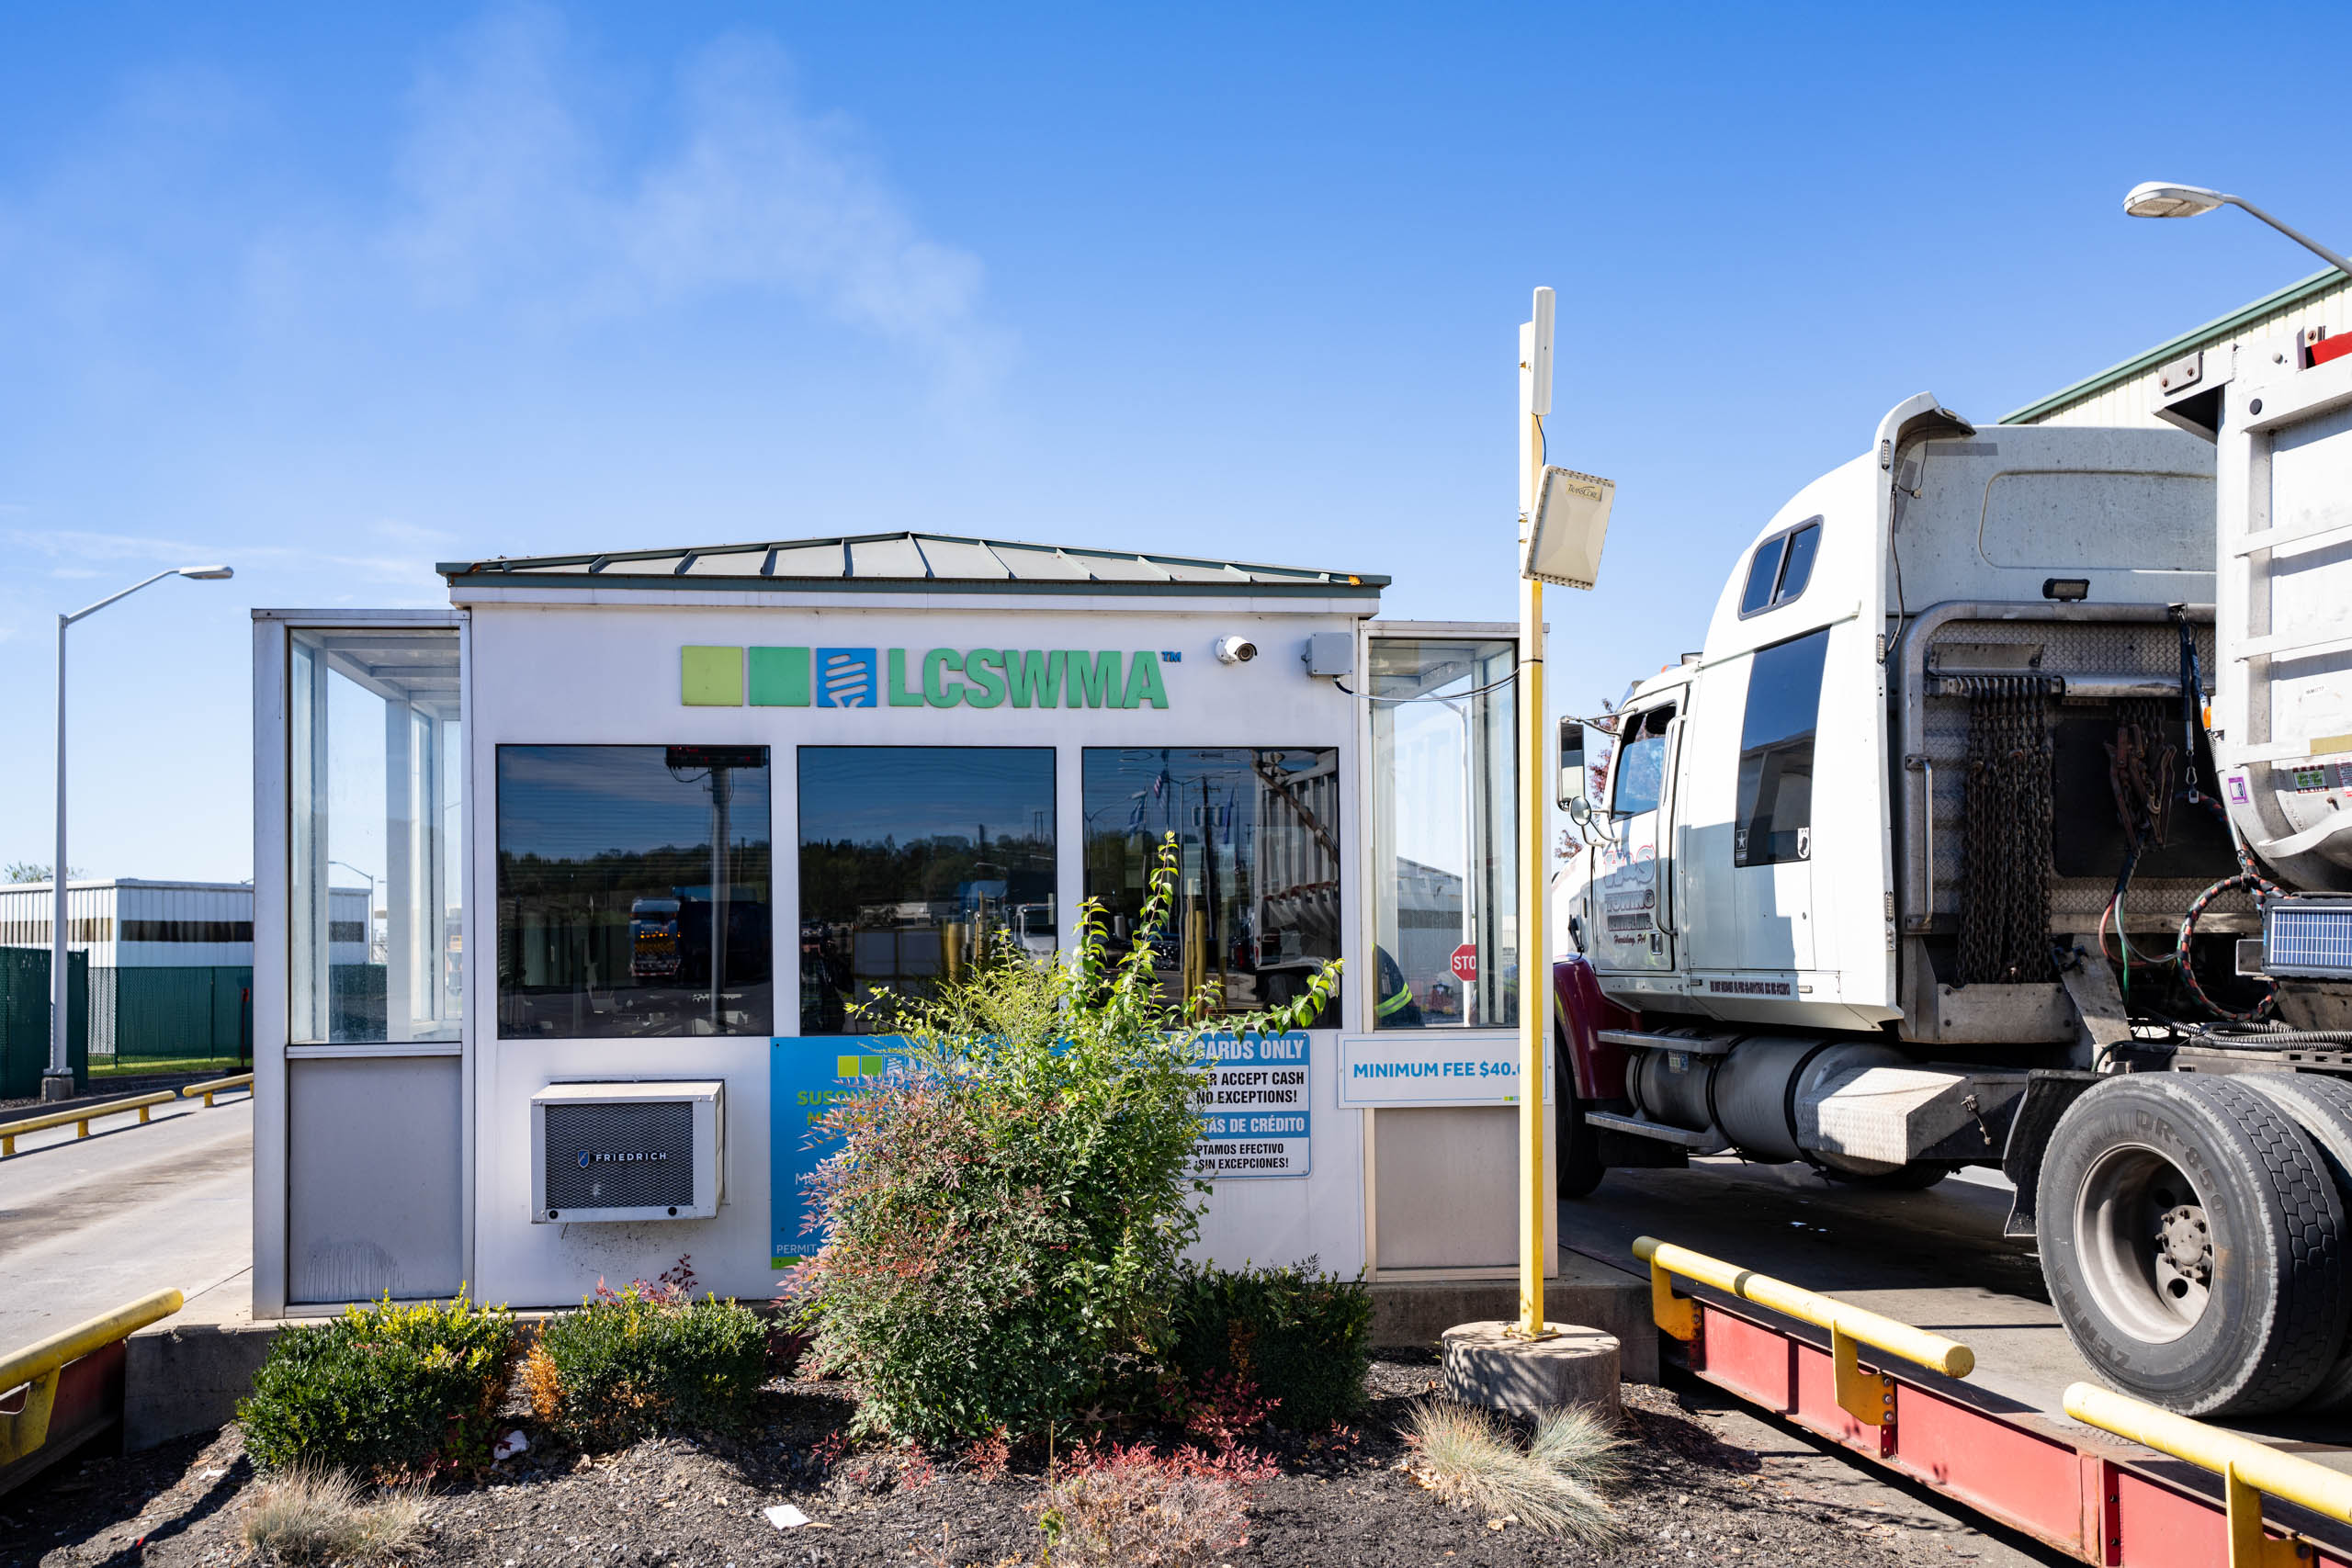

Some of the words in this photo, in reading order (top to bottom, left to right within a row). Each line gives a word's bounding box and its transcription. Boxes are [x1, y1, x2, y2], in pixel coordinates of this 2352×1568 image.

[888, 647, 1169, 709] LCSWMA
[1453, 955, 1476, 970] STO
[1260, 1039, 1304, 1059] ONLY
[1353, 1063, 1439, 1078] MINIMUM
[1443, 1062, 1476, 1077] FEE
[1221, 1072, 1268, 1086] ACCEPT
[1272, 1071, 1305, 1085] CASH
[1196, 1090, 1214, 1103] NO
[1217, 1089, 1297, 1103] EXCEPTIONS!
[1229, 1118, 1247, 1133] DE
[1250, 1114, 1305, 1133] CRÉDITO
[1187, 1144, 1237, 1155] PTAMOS
[1239, 1143, 1284, 1155] EFECTIVO
[595, 1152, 667, 1162] FRIEDRICH
[1218, 1157, 1289, 1169] EXCEPCIONES!
[776, 1243, 817, 1254] PERMIT
